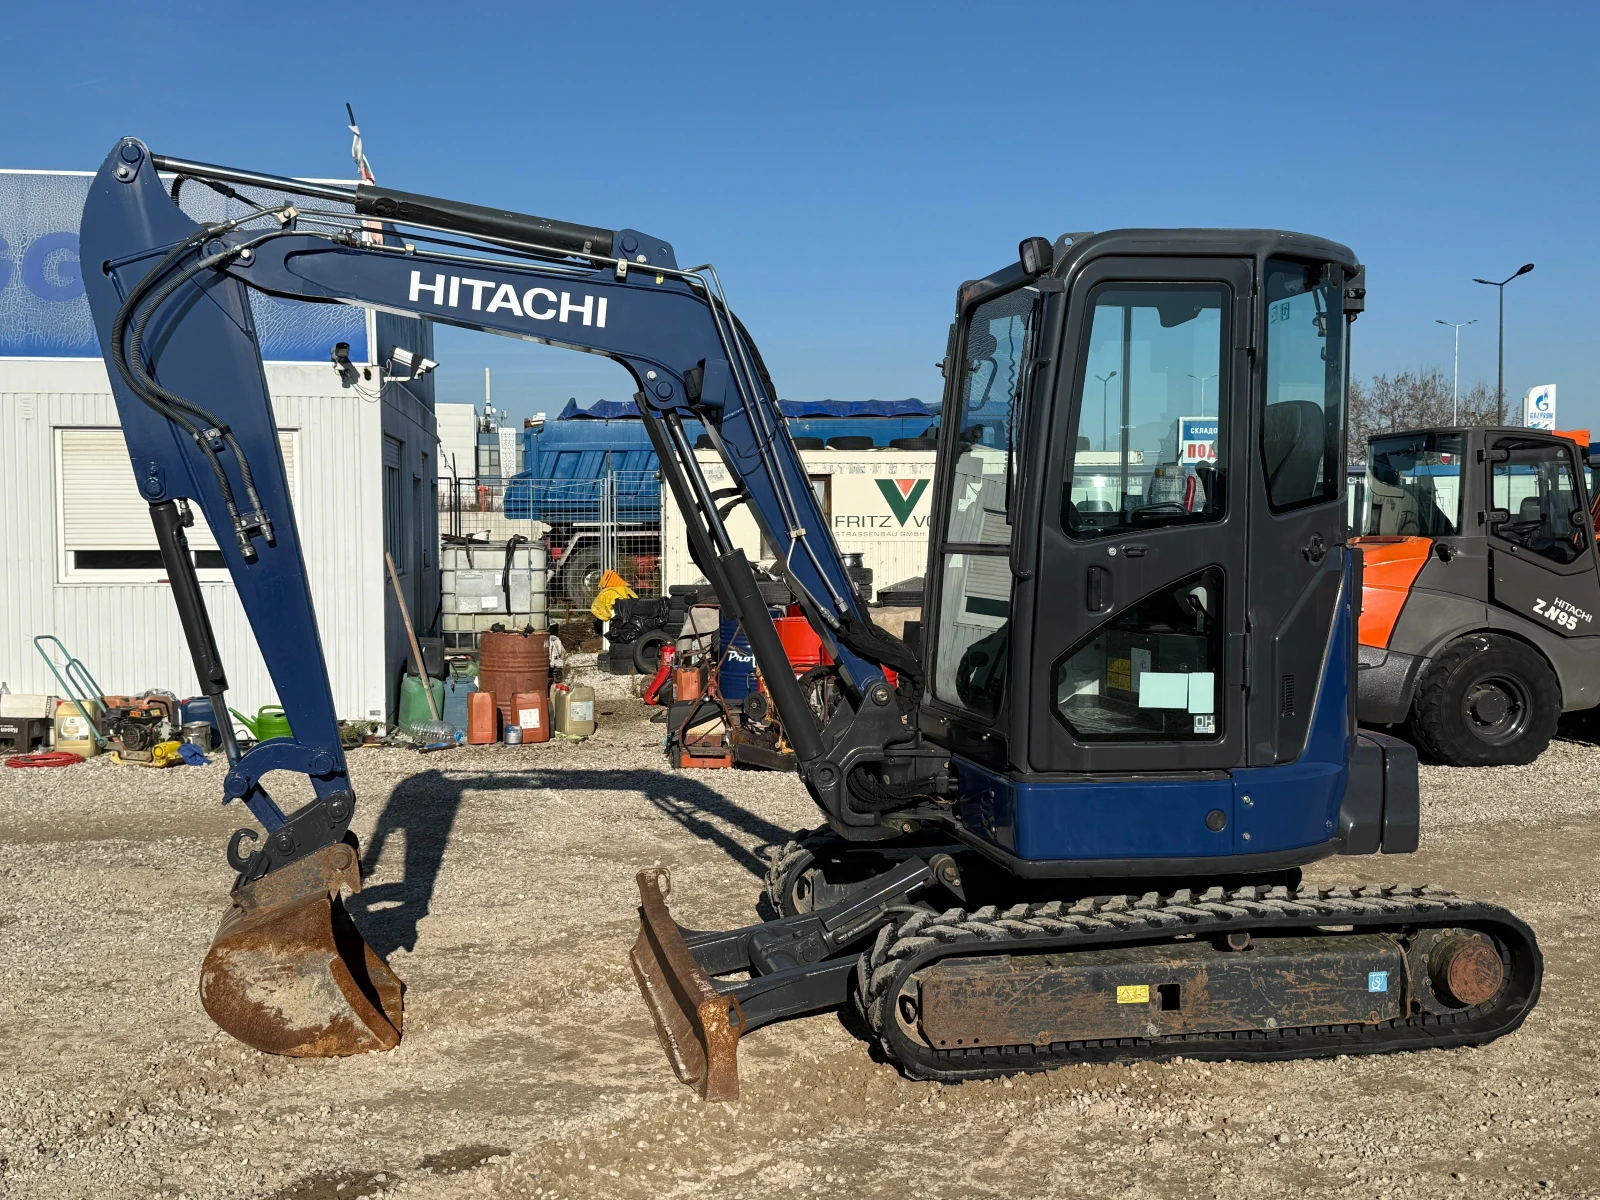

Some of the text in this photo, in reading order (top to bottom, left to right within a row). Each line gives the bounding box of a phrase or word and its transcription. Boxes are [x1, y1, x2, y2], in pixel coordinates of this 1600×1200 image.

[408, 270, 608, 328] HITACHI
[1187, 443, 1217, 460] ПОД
[835, 515, 892, 528] FRITZ
[1553, 596, 1593, 623] HITACHI
